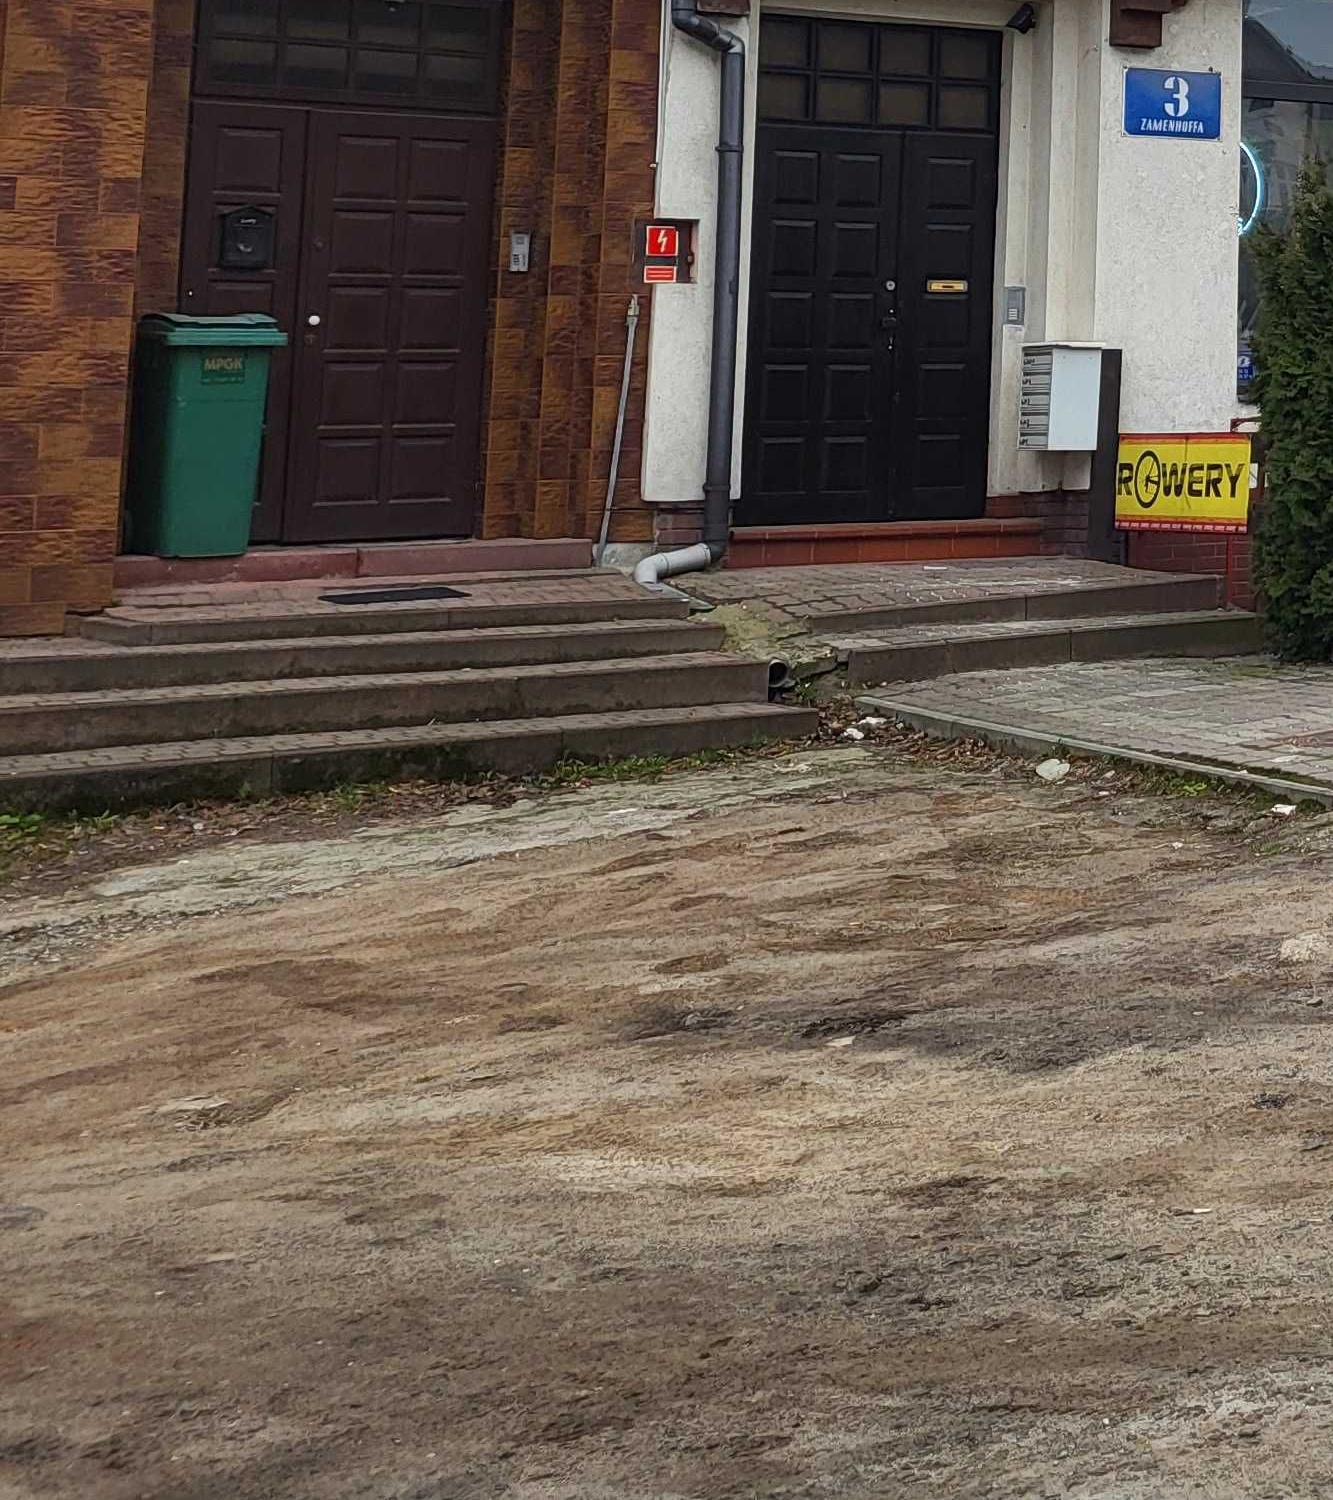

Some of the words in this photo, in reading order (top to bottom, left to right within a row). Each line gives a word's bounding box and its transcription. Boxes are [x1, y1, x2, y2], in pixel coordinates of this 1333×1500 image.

[1164, 76, 1190, 117] 3
[1140, 118, 1204, 134] ZAMENHOFFA
[203, 357, 243, 372] MPGK
[1117, 450, 1246, 509] ROWERY
